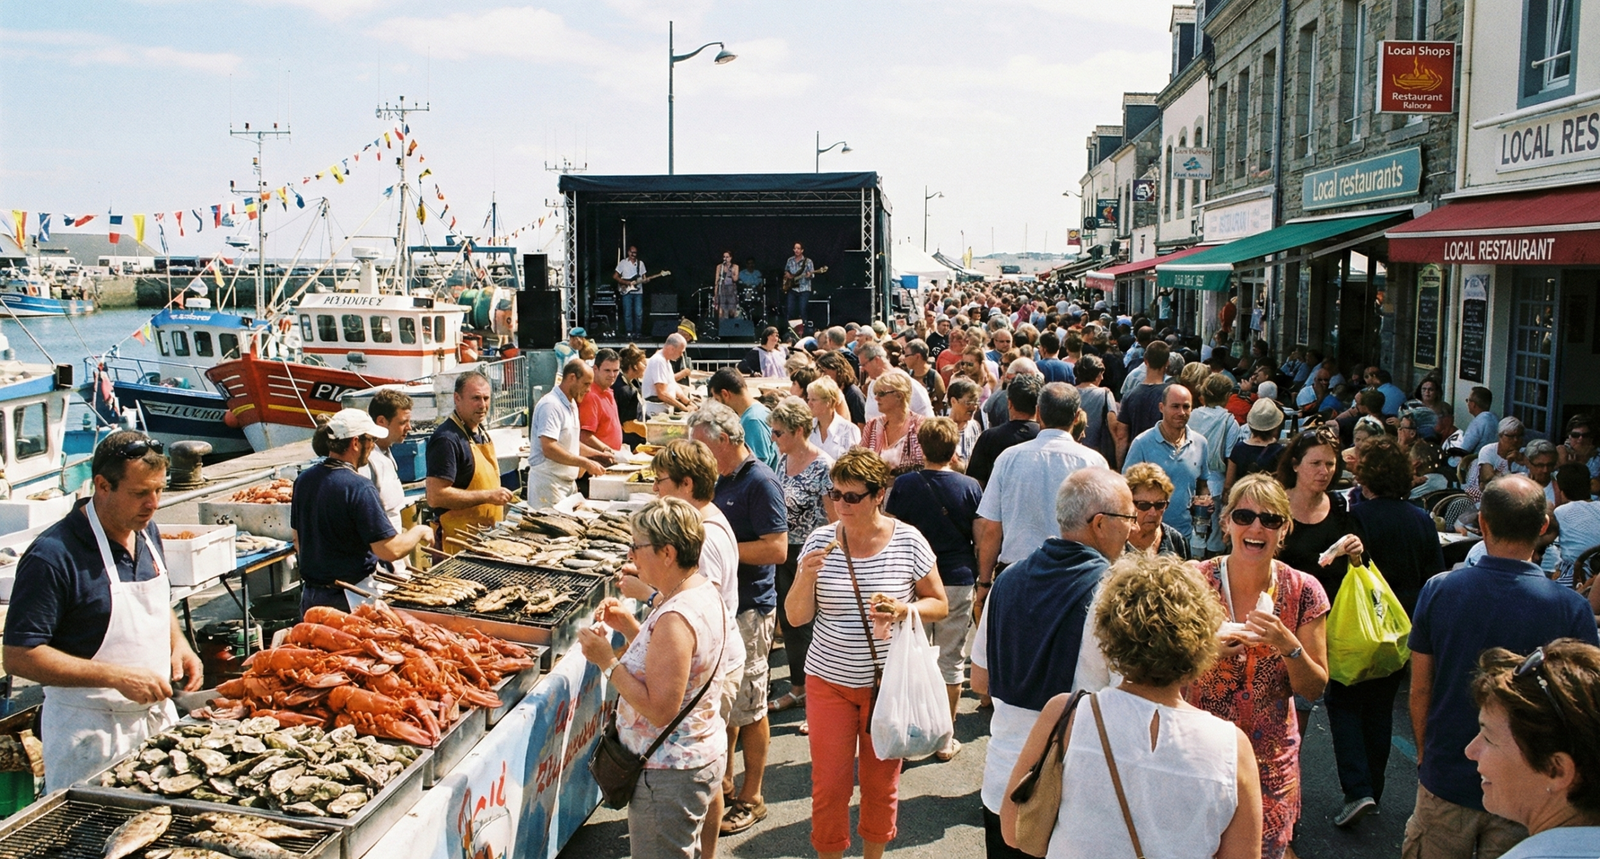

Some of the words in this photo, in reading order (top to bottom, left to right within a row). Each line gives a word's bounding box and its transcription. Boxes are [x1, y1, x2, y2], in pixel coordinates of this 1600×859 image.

[1388, 46, 1415, 56] Local
[1418, 46, 1451, 58] Shops
[1392, 92, 1443, 101] Restaurant
[1501, 123, 1554, 165] LOCAL
[1561, 112, 1600, 155] RES
[1313, 171, 1338, 202] Local
[1340, 159, 1403, 197] restaurants
[1444, 240, 1476, 261] LOCAL
[1478, 238, 1556, 261] RESTAURANT
